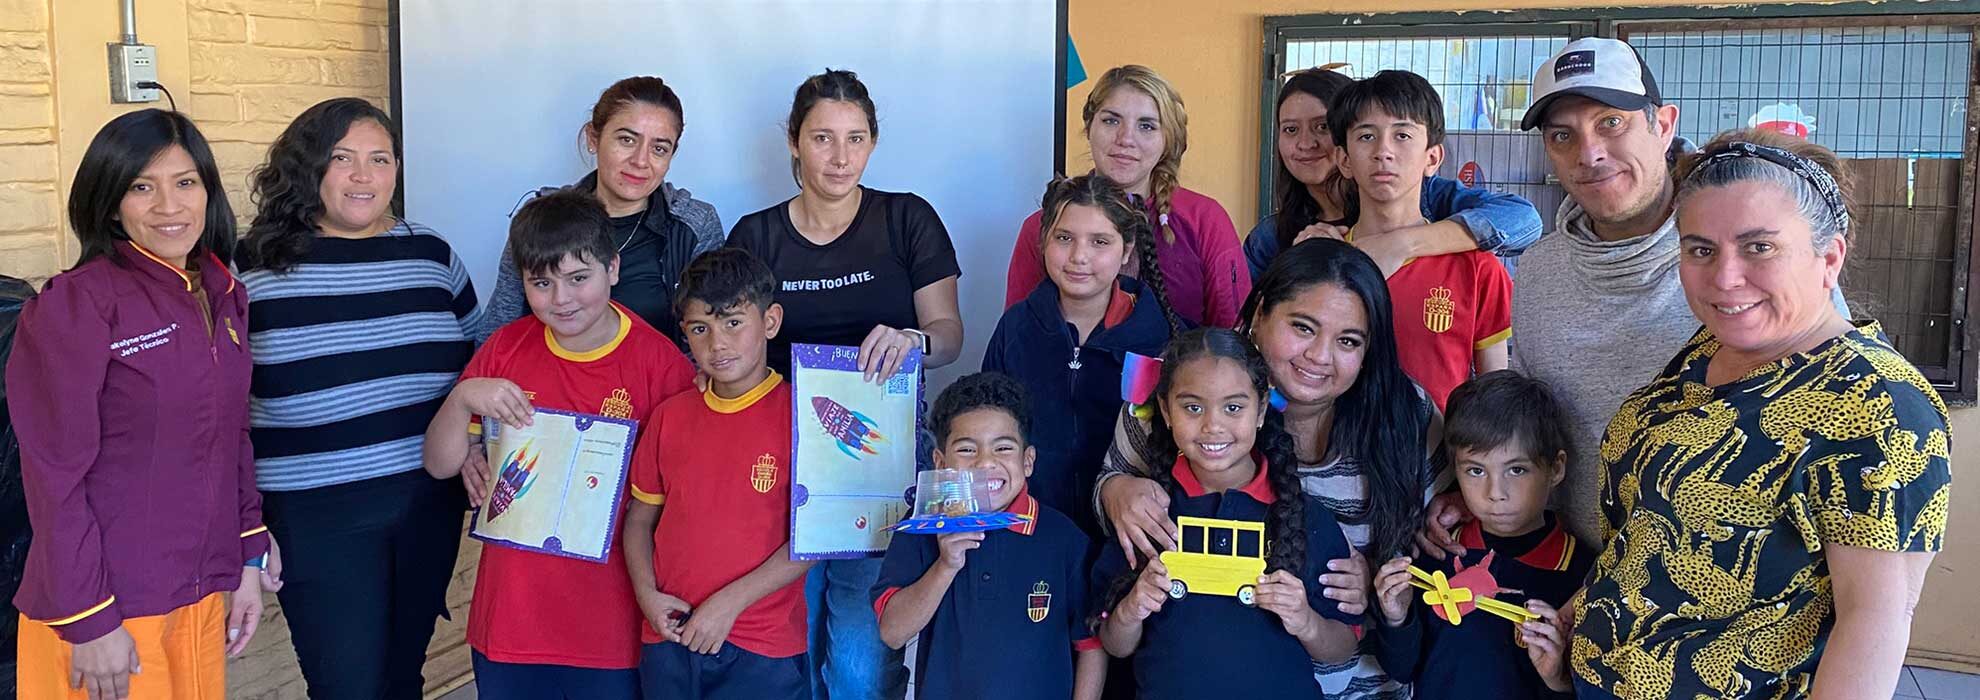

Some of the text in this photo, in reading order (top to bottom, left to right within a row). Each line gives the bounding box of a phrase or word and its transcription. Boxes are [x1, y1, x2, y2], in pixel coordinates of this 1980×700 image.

[782, 270, 875, 291] NEVER TOO LATE.
[120, 345, 140, 357] Jefe
